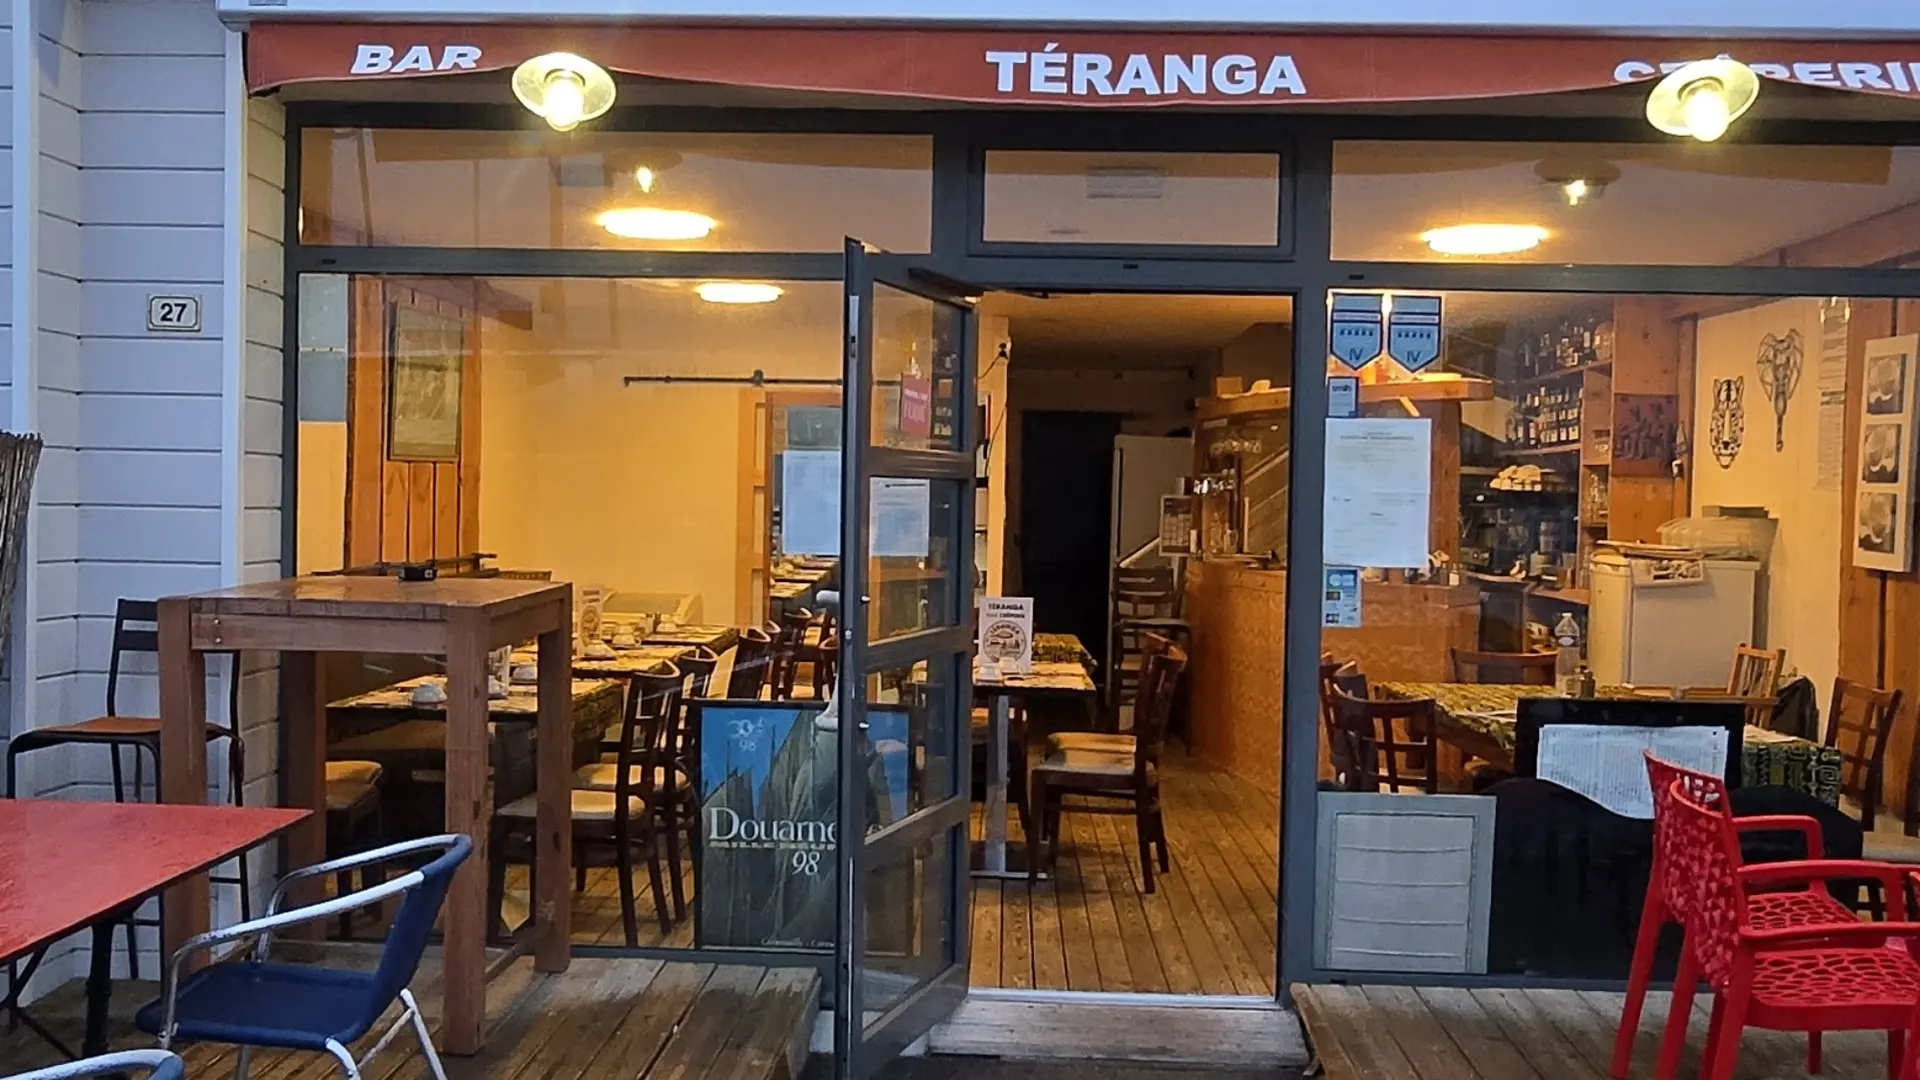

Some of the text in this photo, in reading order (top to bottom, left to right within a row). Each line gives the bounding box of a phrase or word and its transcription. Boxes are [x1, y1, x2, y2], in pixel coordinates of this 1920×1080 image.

[350, 44, 482, 74] BAR
[985, 42, 1307, 96] TÉRANGA
[1613, 61, 1920, 92] CPERI
[160, 302, 187, 322] 27
[1348, 348, 1364, 361] IV
[1406, 350, 1421, 363] IV
[791, 850, 821, 876] 98
